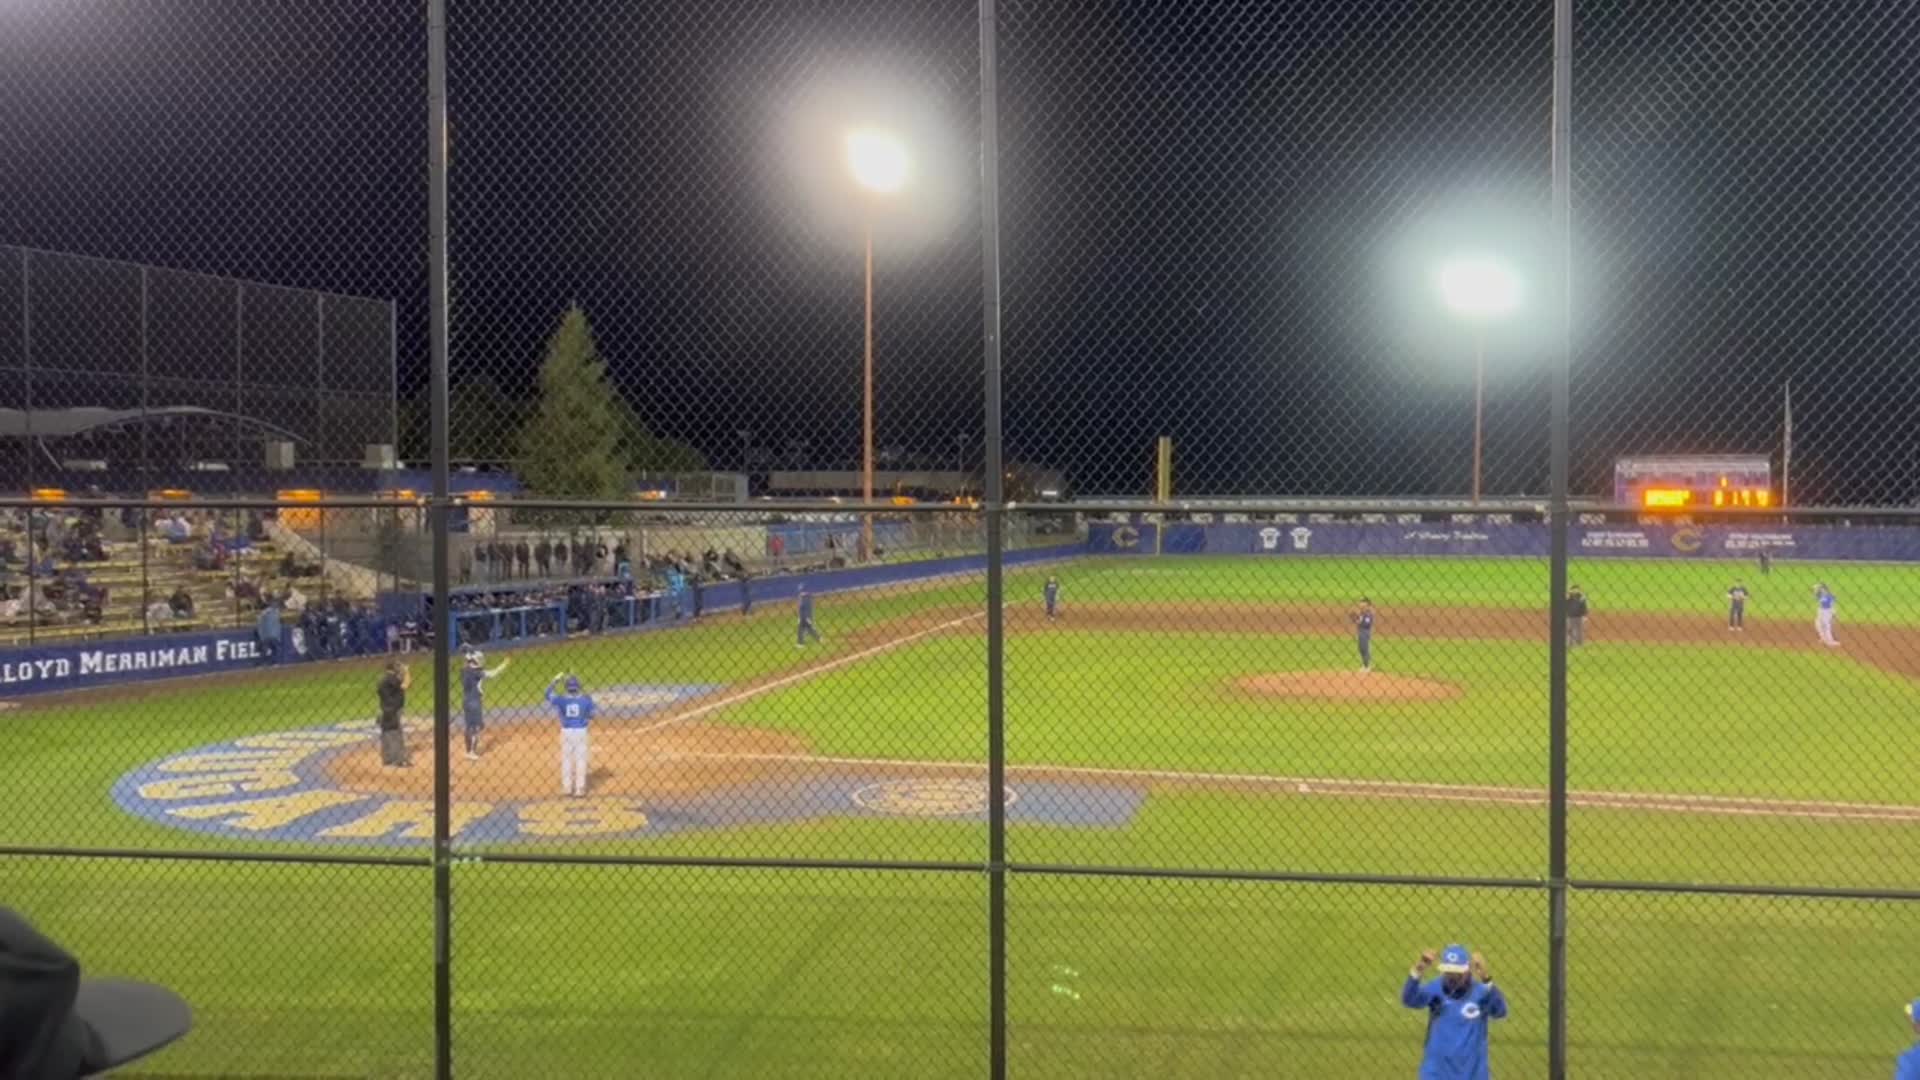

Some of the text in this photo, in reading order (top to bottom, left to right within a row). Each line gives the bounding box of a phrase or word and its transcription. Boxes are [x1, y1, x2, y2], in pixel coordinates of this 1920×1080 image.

[0, 640, 273, 683] LOYD MERRIMAN FIEL
[566, 704, 579, 717] 19
[1461, 1002, 1481, 1019] C
